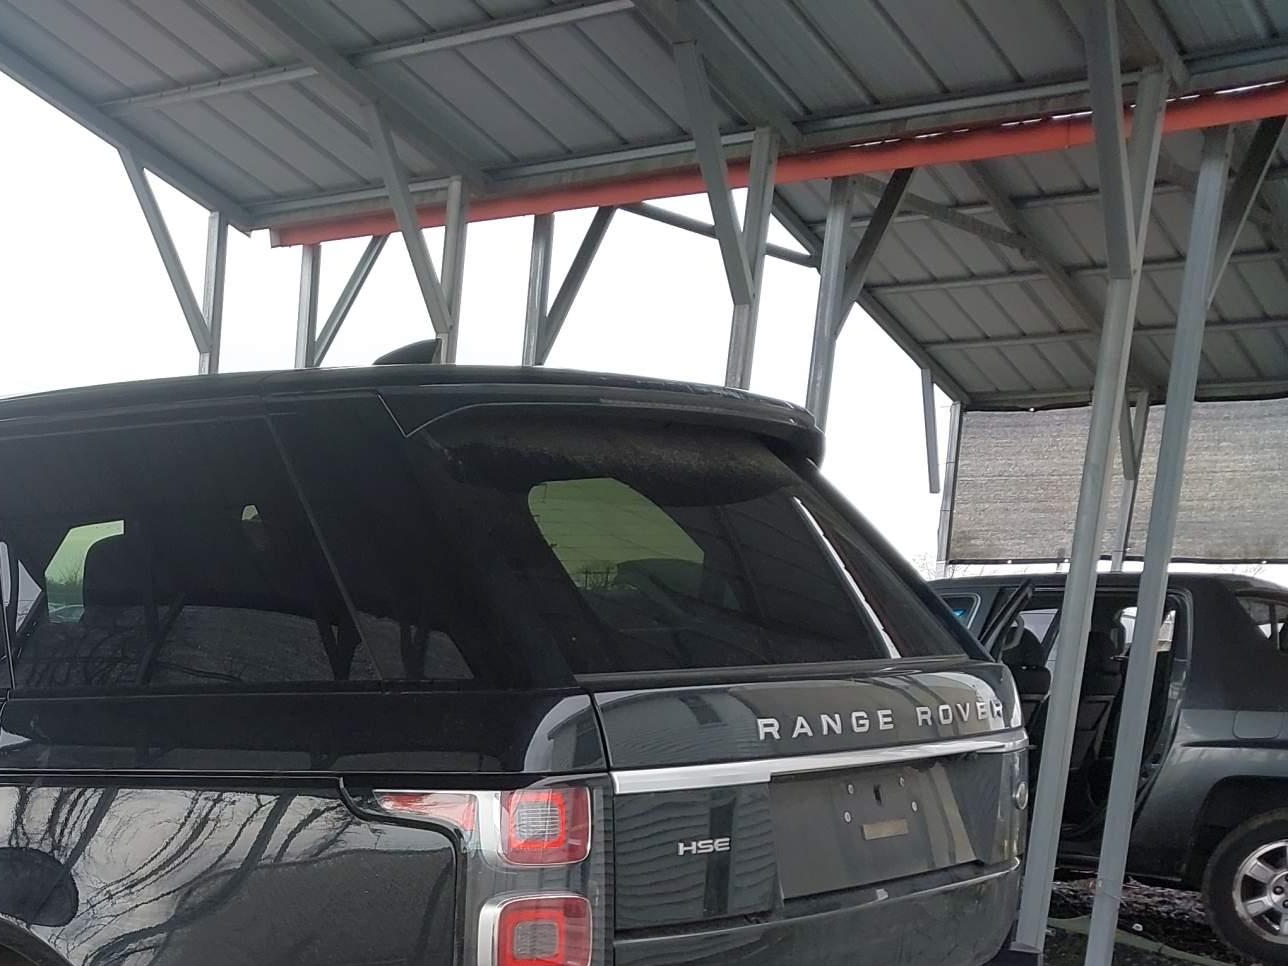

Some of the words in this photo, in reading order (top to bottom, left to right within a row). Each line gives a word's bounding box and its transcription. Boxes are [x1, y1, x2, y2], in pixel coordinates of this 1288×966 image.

[756, 709, 894, 741] RANGE
[916, 700, 1004, 727] ROVER
[677, 837, 731, 856] HSE
